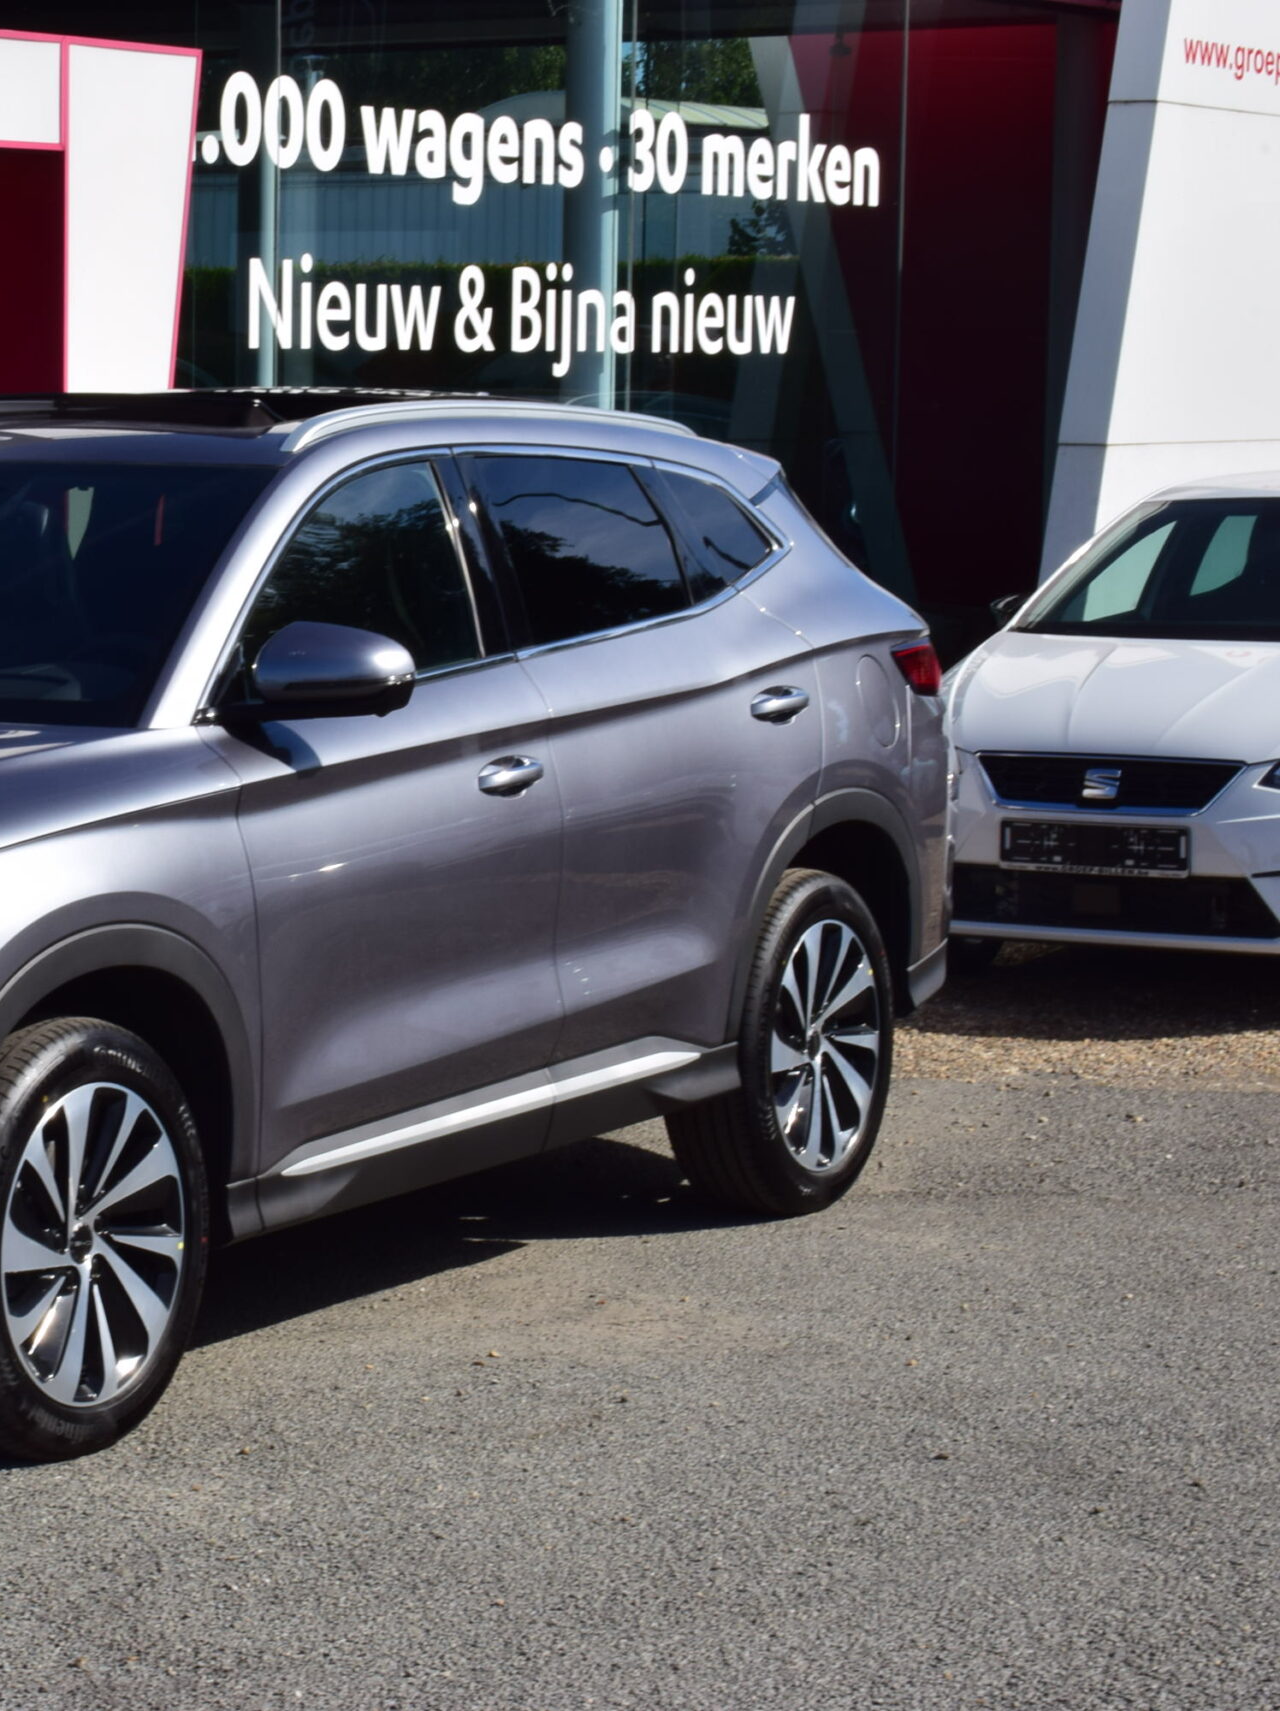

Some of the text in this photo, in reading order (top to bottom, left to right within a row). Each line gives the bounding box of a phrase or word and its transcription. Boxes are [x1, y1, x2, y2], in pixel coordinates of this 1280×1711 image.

[192, 71, 880, 207] .000 wagens 30 merken
[248, 253, 796, 377] Nieuw & Bijna nieuw
